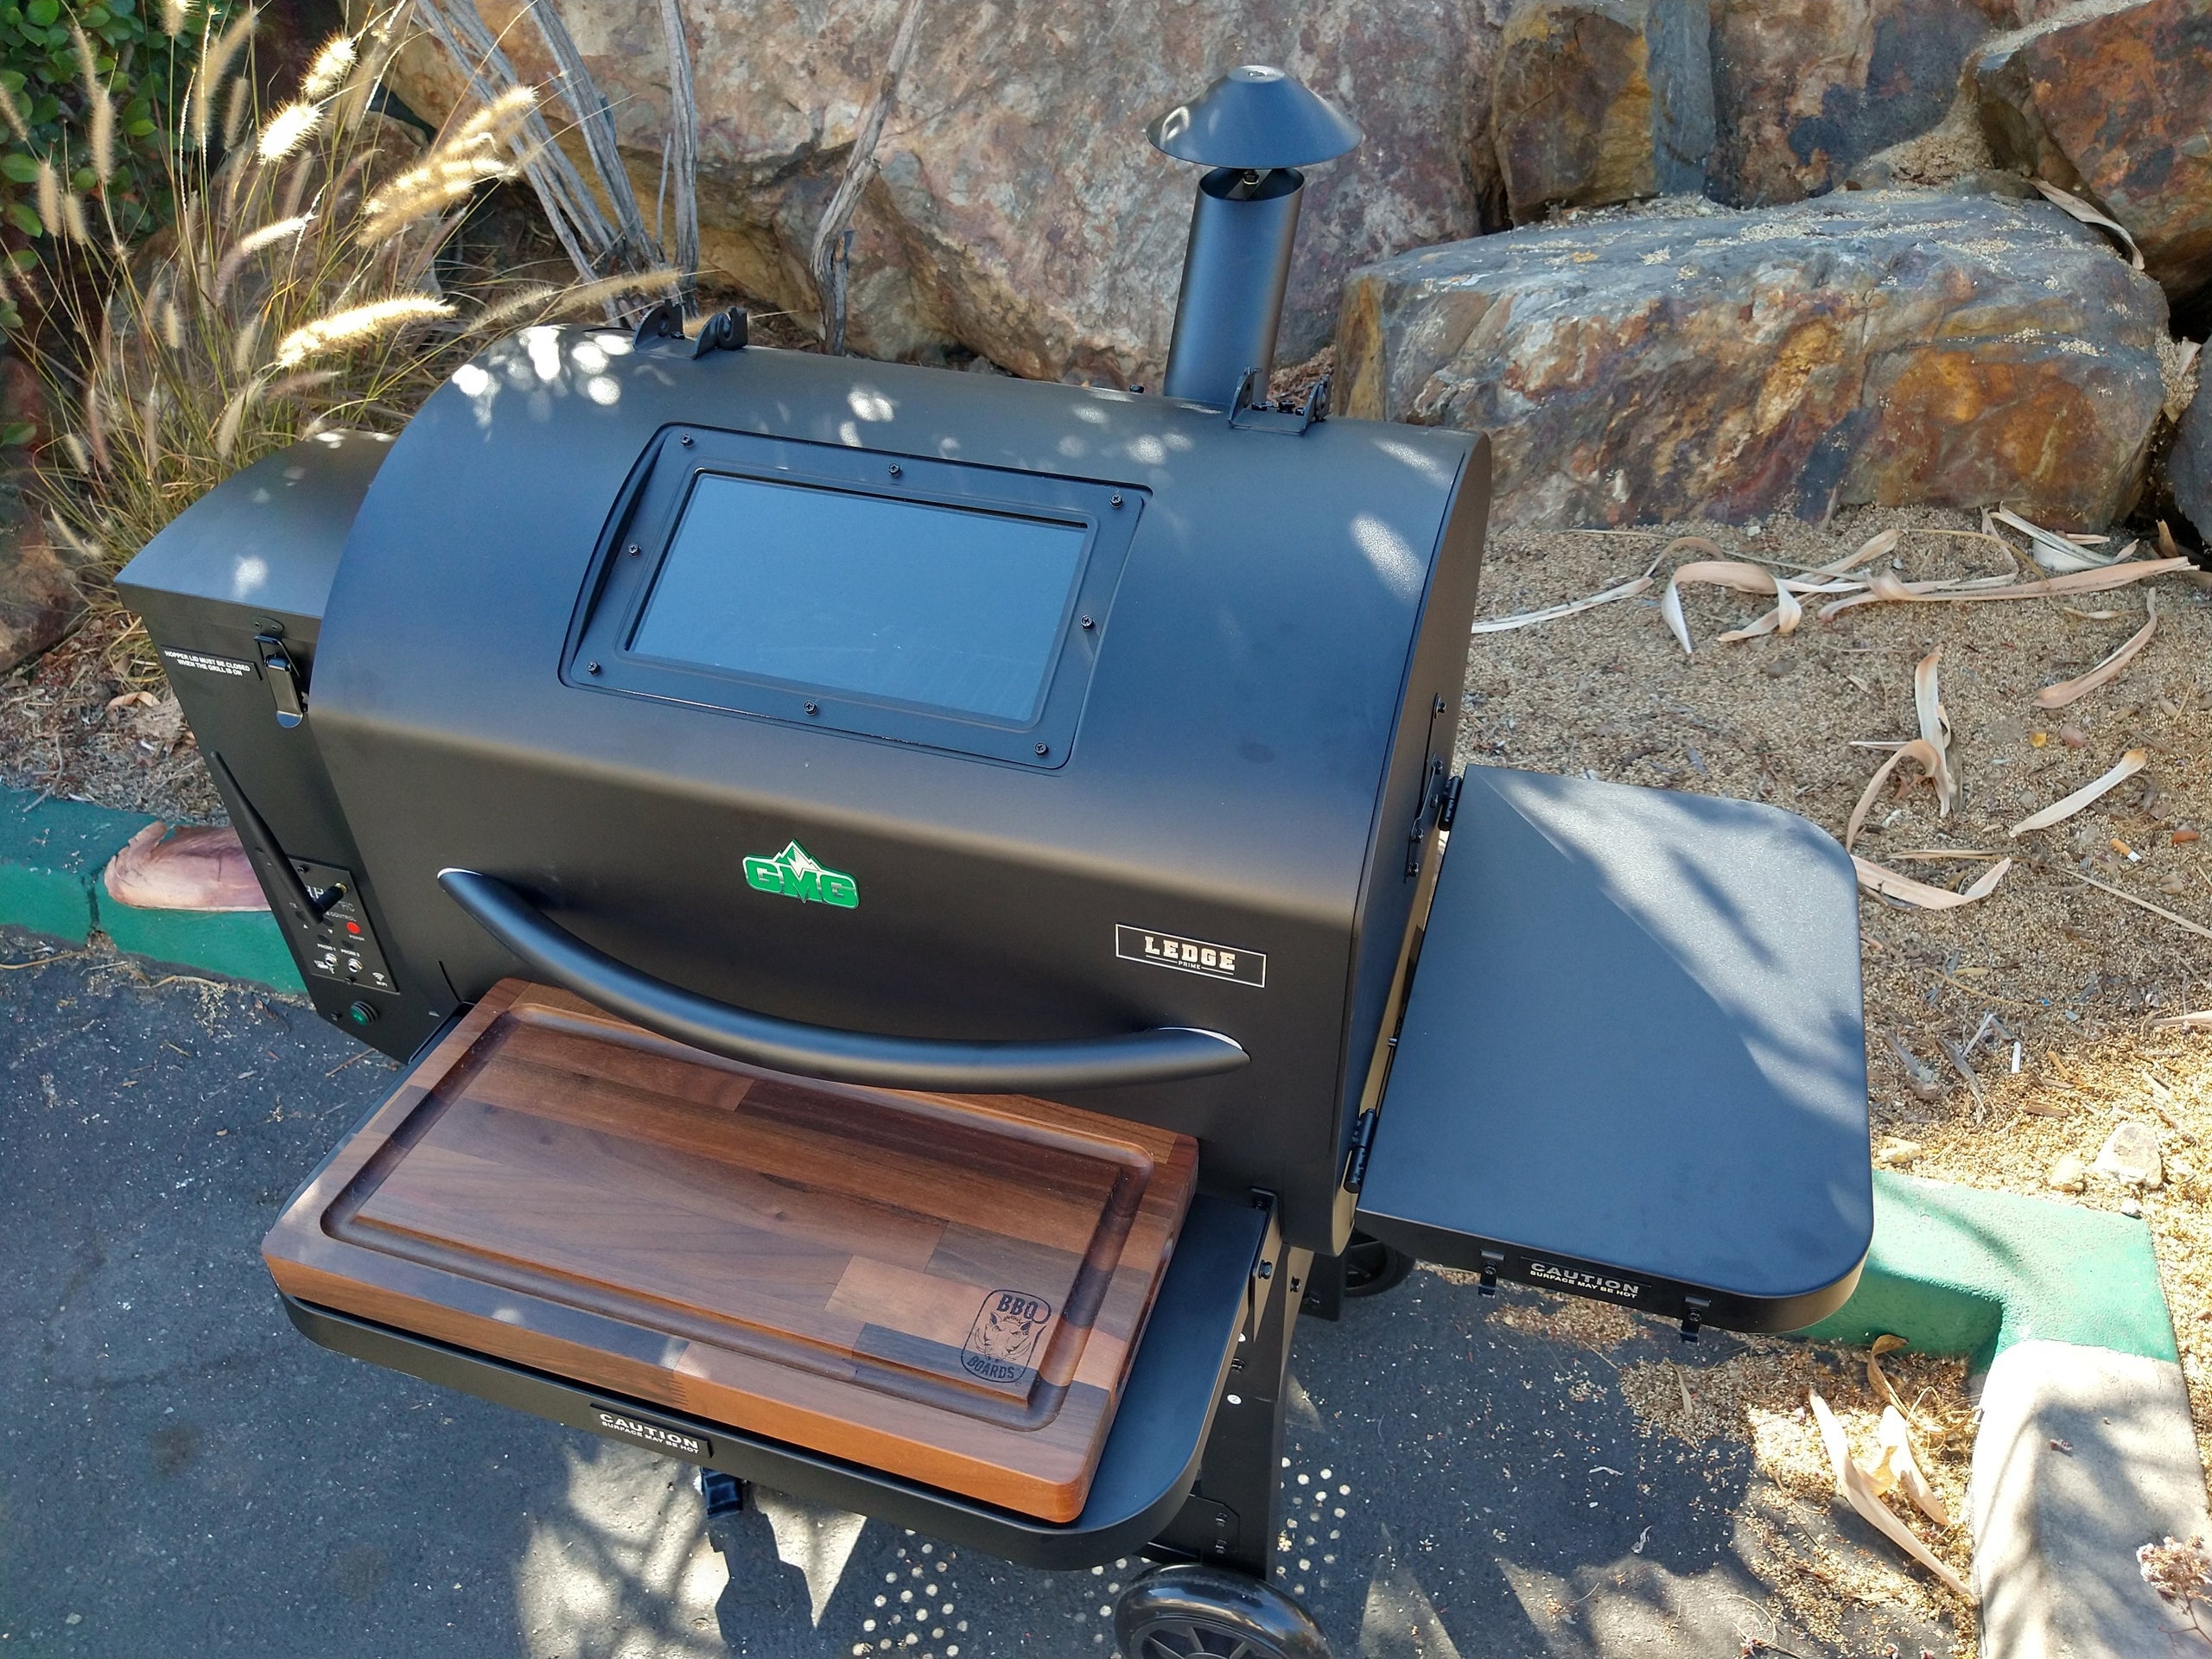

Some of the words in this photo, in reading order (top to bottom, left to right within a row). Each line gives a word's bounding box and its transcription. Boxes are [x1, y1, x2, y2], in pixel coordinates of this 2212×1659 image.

[164, 650, 189, 660] HOPPER
[199, 657, 216, 665] MUST
[226, 662, 251, 671] CLOSED
[176, 658, 196, 667] WHEN
[207, 664, 226, 673] GRILL
[744, 857, 859, 909] GMG
[1145, 936, 1236, 971] LEDGE
[1178, 960, 1201, 970] PRIME
[1530, 1262, 1639, 1294] CAUTION
[1530, 1270, 1575, 1286] SURFACE
[1577, 1281, 1599, 1290] MAY
[1616, 1289, 1638, 1300] HOT
[996, 1294, 1039, 1321] BBQ
[967, 1355, 1015, 1379] BOARDS
[600, 1413, 700, 1450] CAUTION
[601, 1421, 643, 1438] SURFACE
[645, 1433, 664, 1444] MAY
[665, 1440, 679, 1448] BE
[680, 1444, 700, 1454] HOT
